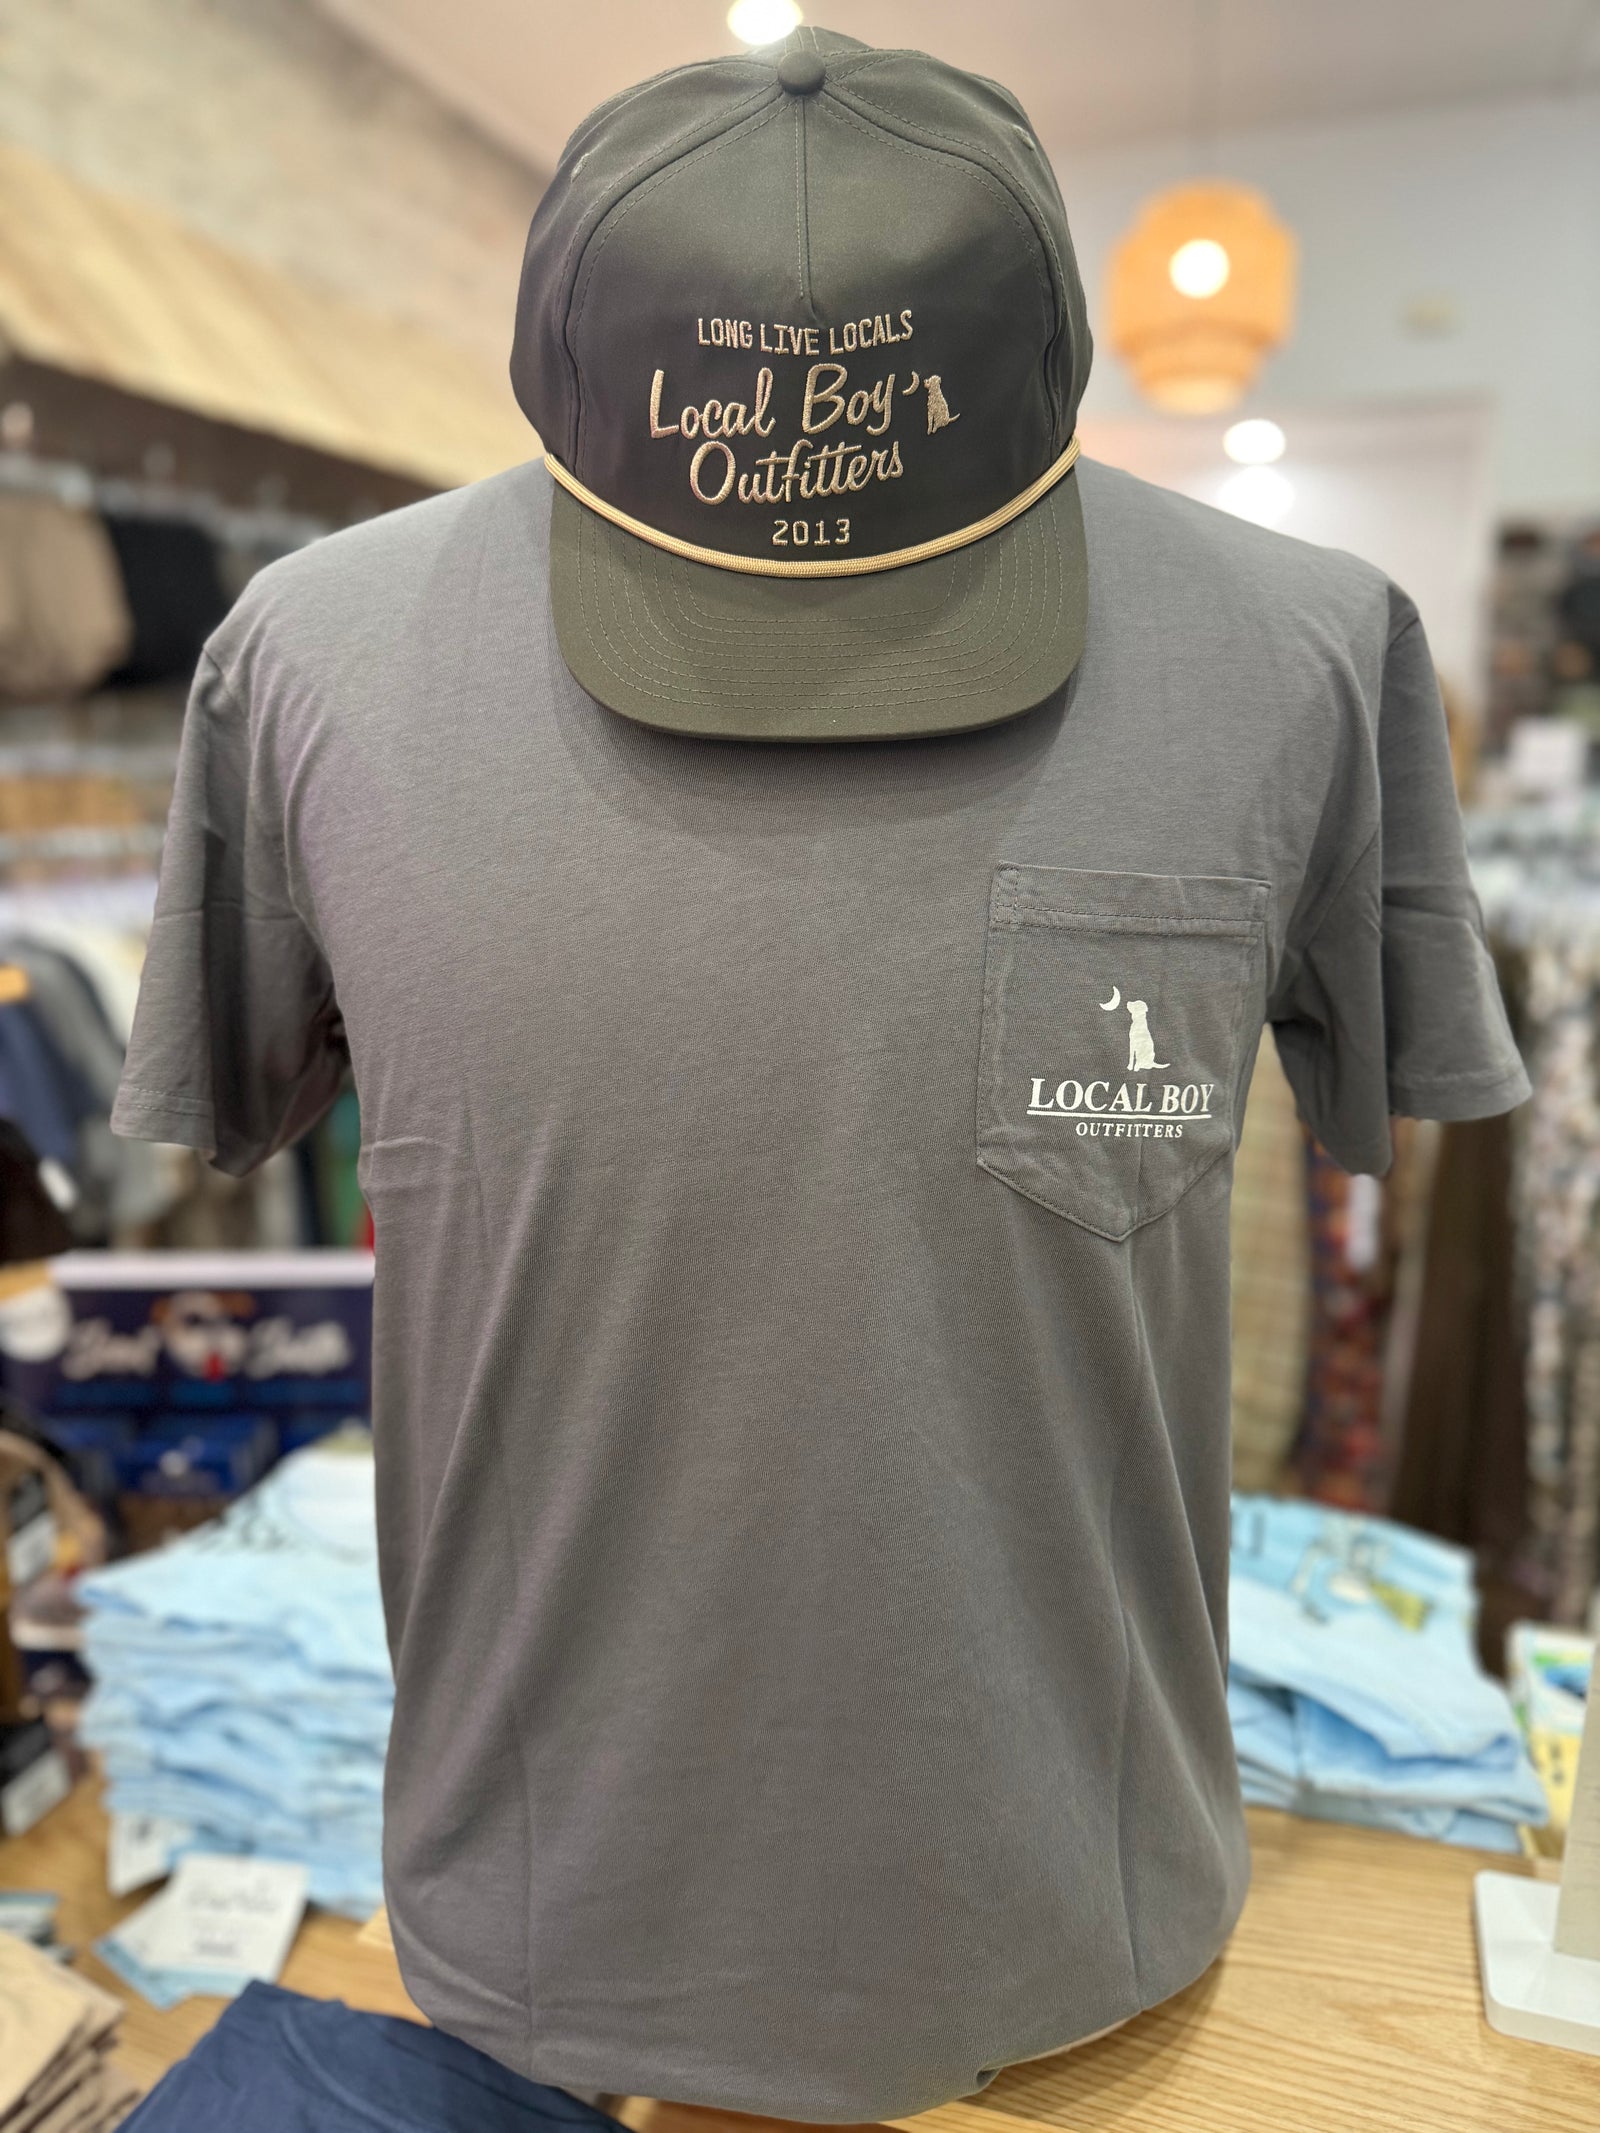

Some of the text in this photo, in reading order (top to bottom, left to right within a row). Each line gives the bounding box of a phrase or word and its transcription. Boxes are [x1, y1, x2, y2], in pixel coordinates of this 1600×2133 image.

[697, 309, 914, 356] LONG LIVE LOCALS
[650, 363, 896, 439] Local Boy
[689, 439, 904, 505] Outfitters
[772, 519, 851, 546] 2013
[1028, 1077, 1215, 1114] LOCAL BOY
[1075, 1121, 1184, 1138] OUTFITTERS
